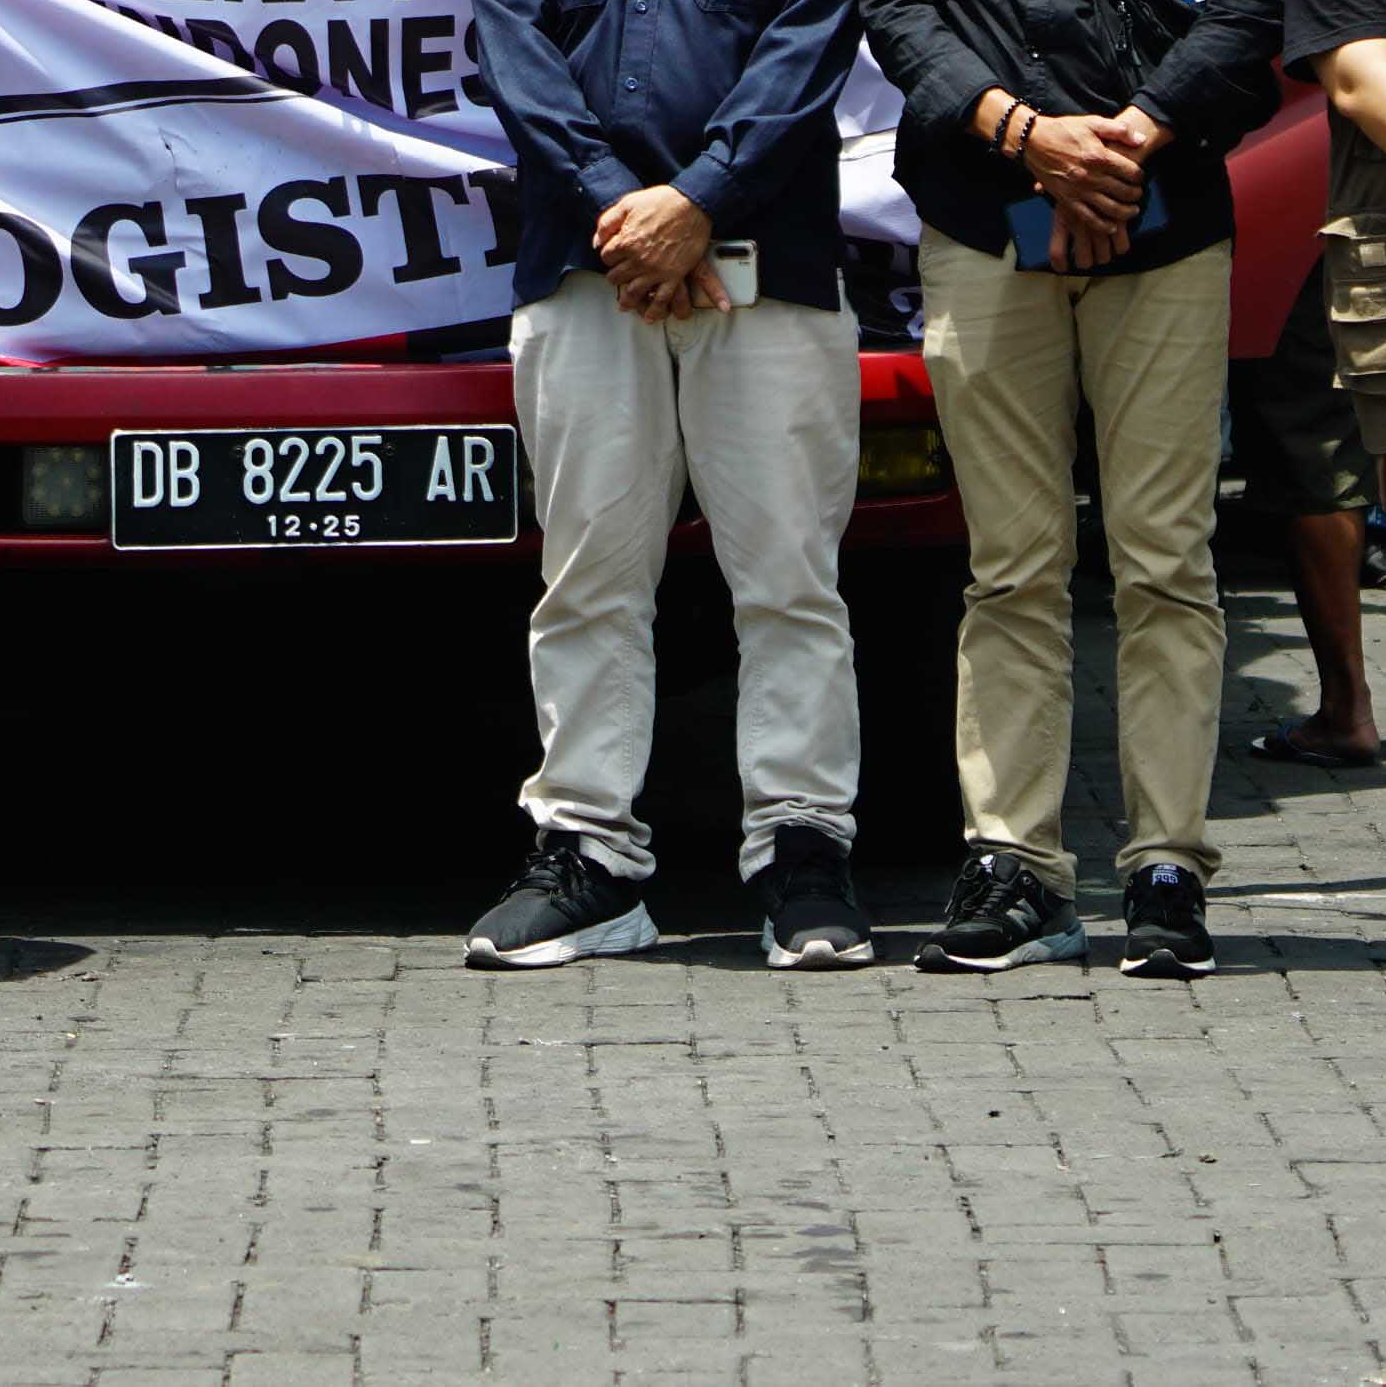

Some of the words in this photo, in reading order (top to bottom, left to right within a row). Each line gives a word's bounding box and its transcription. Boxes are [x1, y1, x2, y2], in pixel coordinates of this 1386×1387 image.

[132, 440, 201, 509] DB
[242, 435, 384, 506] 8225
[426, 435, 495, 503] AR
